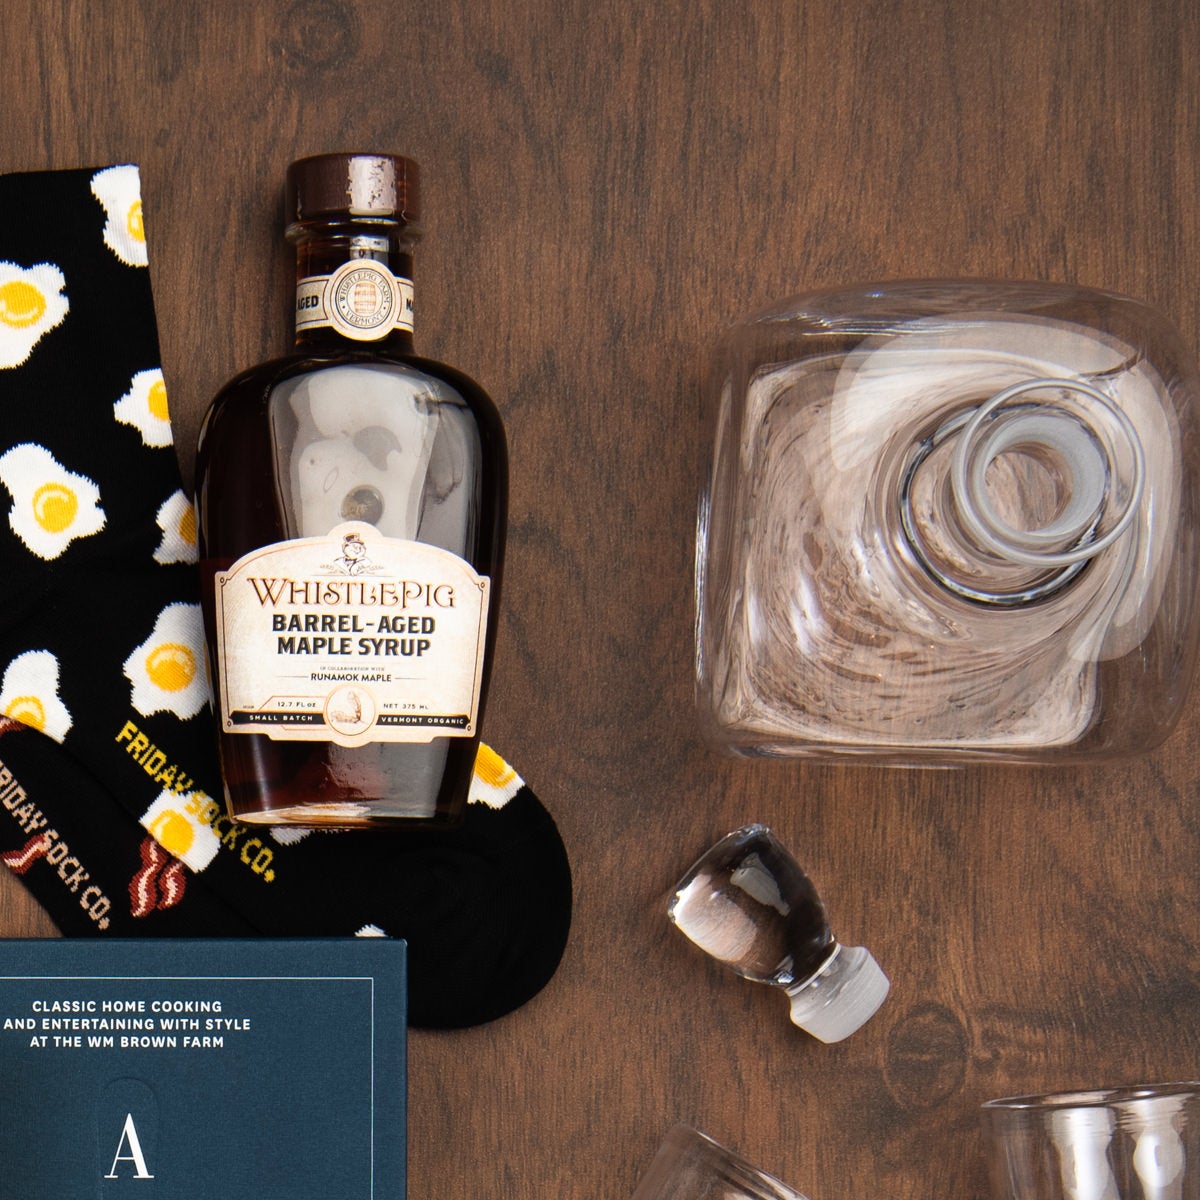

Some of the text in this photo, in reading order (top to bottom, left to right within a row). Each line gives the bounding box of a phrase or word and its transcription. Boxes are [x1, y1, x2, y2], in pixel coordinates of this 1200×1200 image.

[272, 613, 435, 634] BARREL-AGED
[277, 637, 431, 657] MAPLE SYRUP
[311, 673, 392, 683] RUNAMOK MAPLE
[381, 716, 464, 725] VERMONT ORGANIC
[115, 720, 276, 883] FRIDAY SOCK CO.
[43, 829, 90, 893] SOCK
[79, 885, 111, 931] CO.
[32, 1000, 222, 1013] CLASSIC HOME COOKING
[3, 1018, 251, 1031] AND ENTERTAINING WITH STYLE
[29, 1036, 224, 1048] AT THE WM BROWN FARM
[104, 1112, 155, 1179] A
